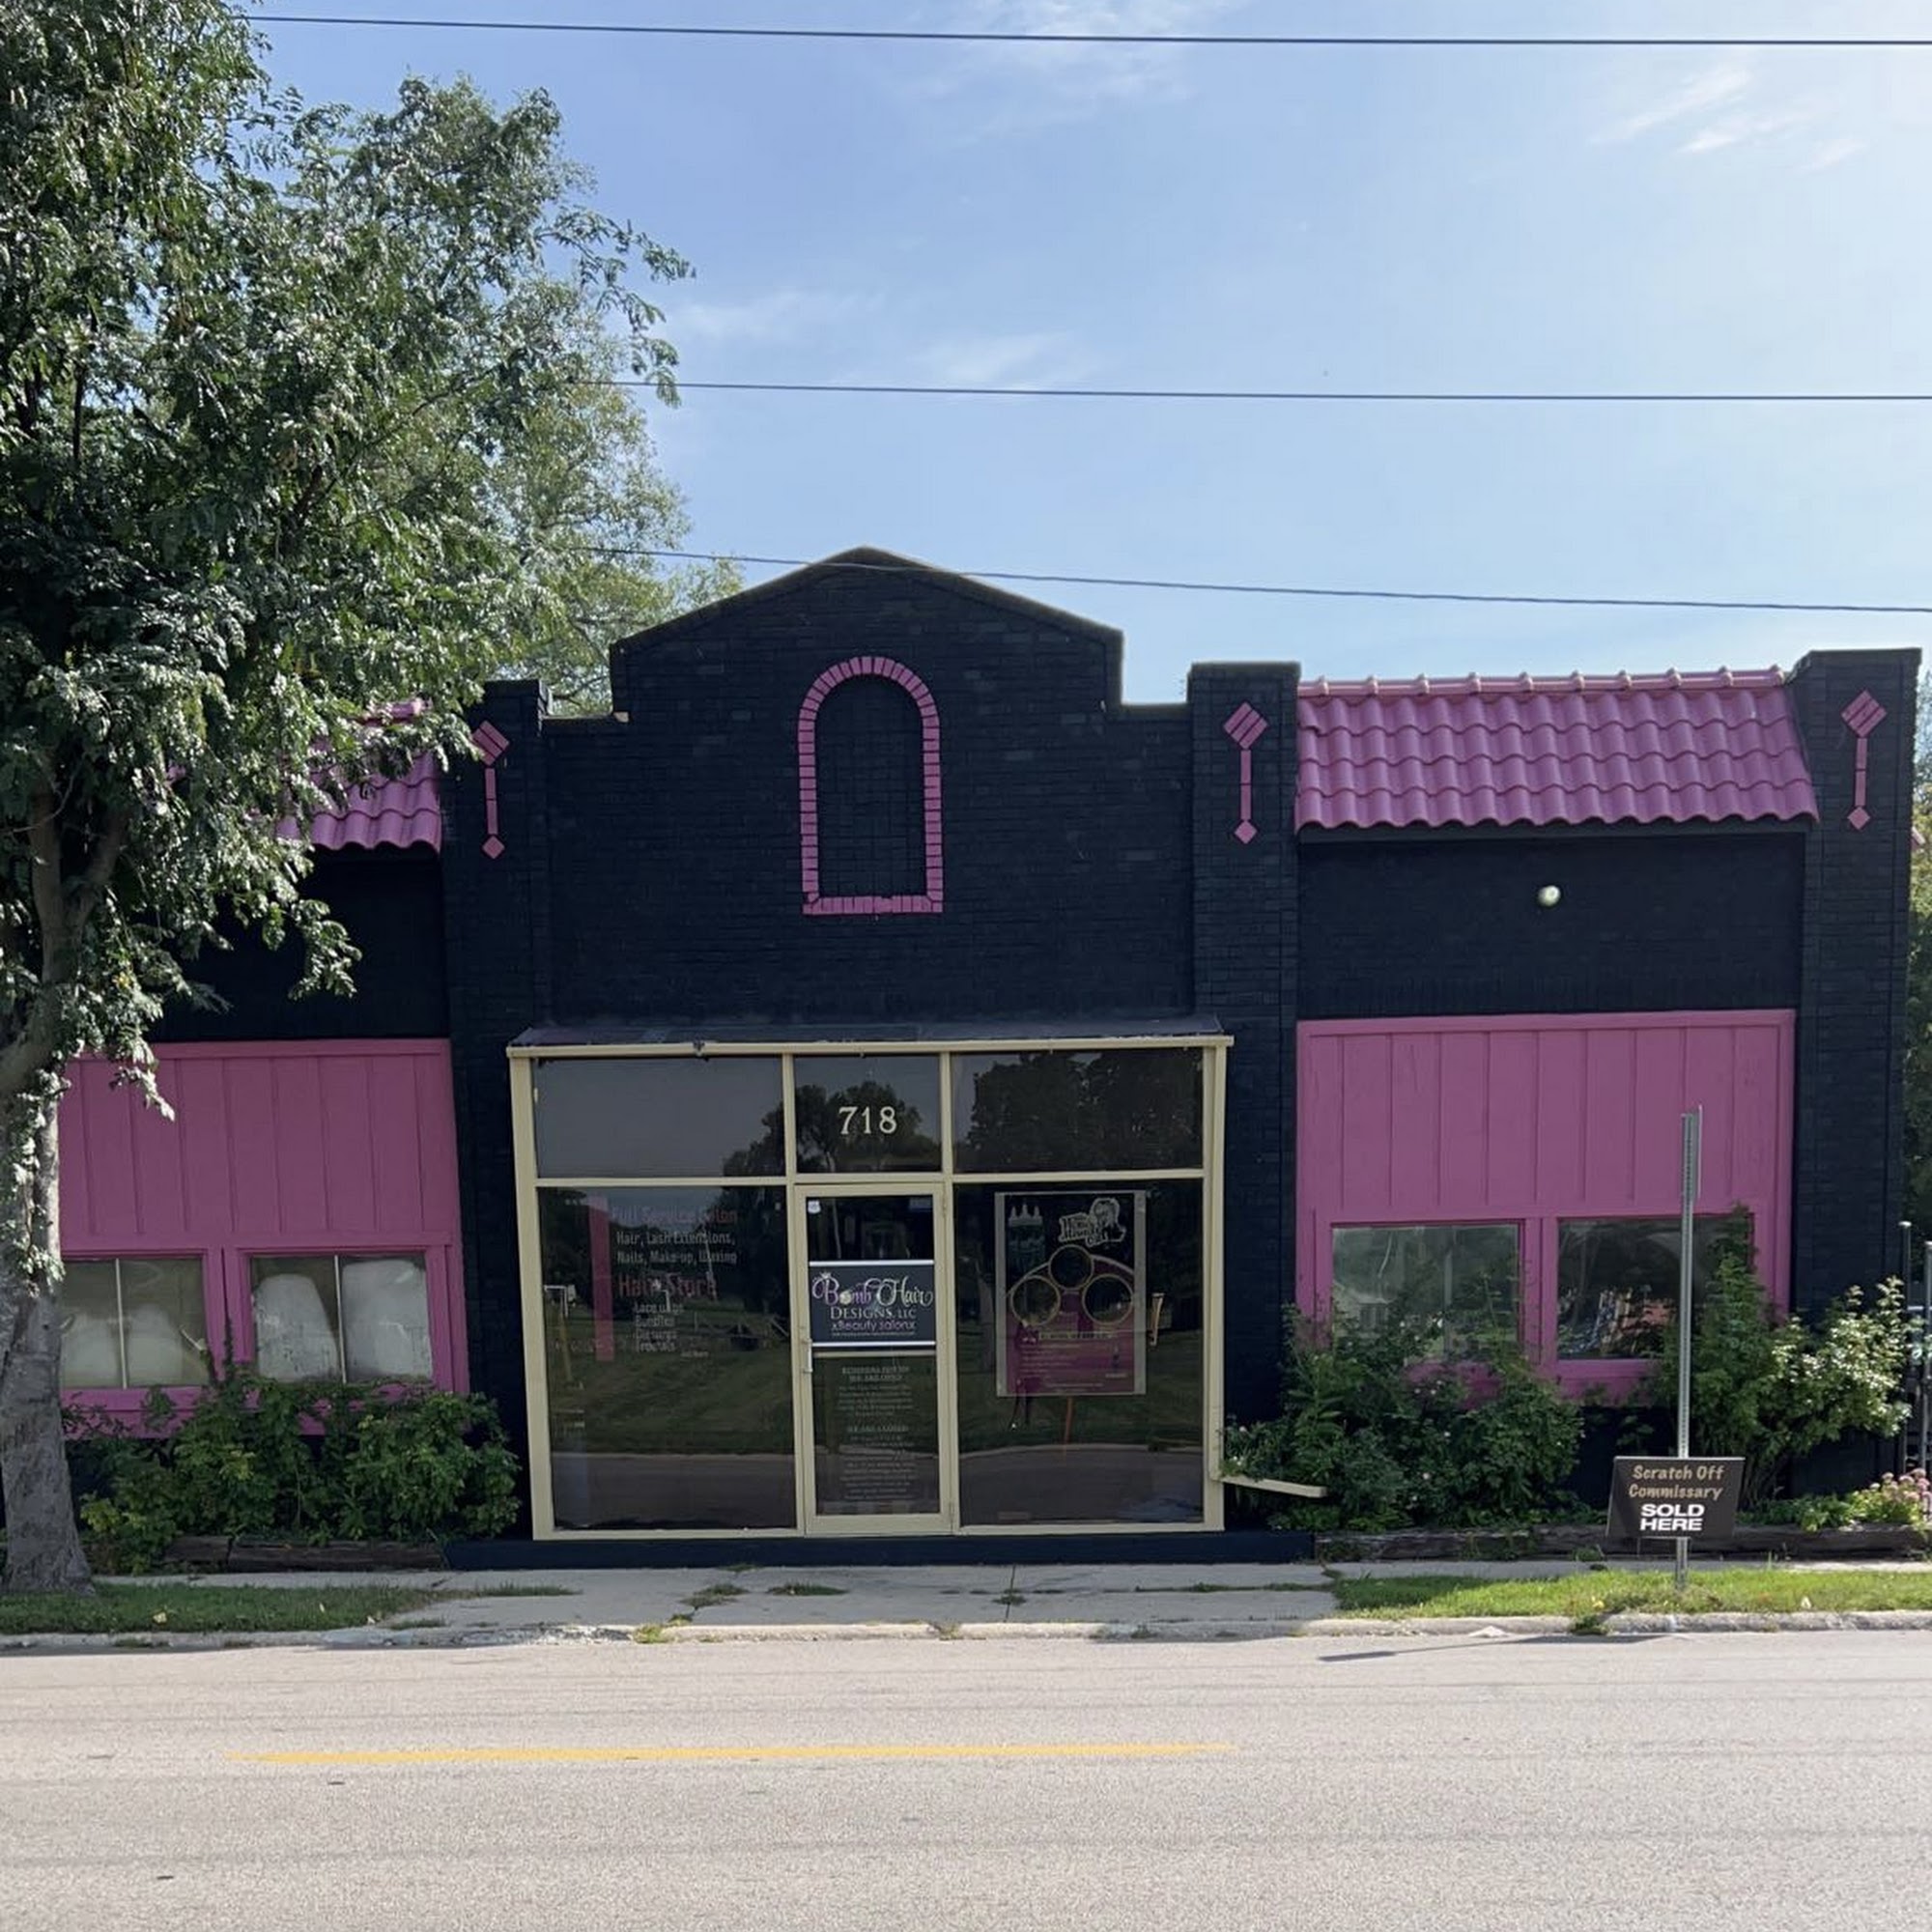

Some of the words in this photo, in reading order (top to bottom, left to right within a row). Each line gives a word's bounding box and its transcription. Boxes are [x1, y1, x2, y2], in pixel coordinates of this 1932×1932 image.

[838, 1106, 897, 1135] 718
[646, 1231, 671, 1244] Lash
[876, 1276, 934, 1307] Hair
[1633, 1464, 1692, 1480] Scratch
[1696, 1465, 1724, 1480] Off
[1629, 1484, 1723, 1500] Commissary
[1640, 1503, 1705, 1518] SOLD
[1639, 1518, 1703, 1531] HERE
